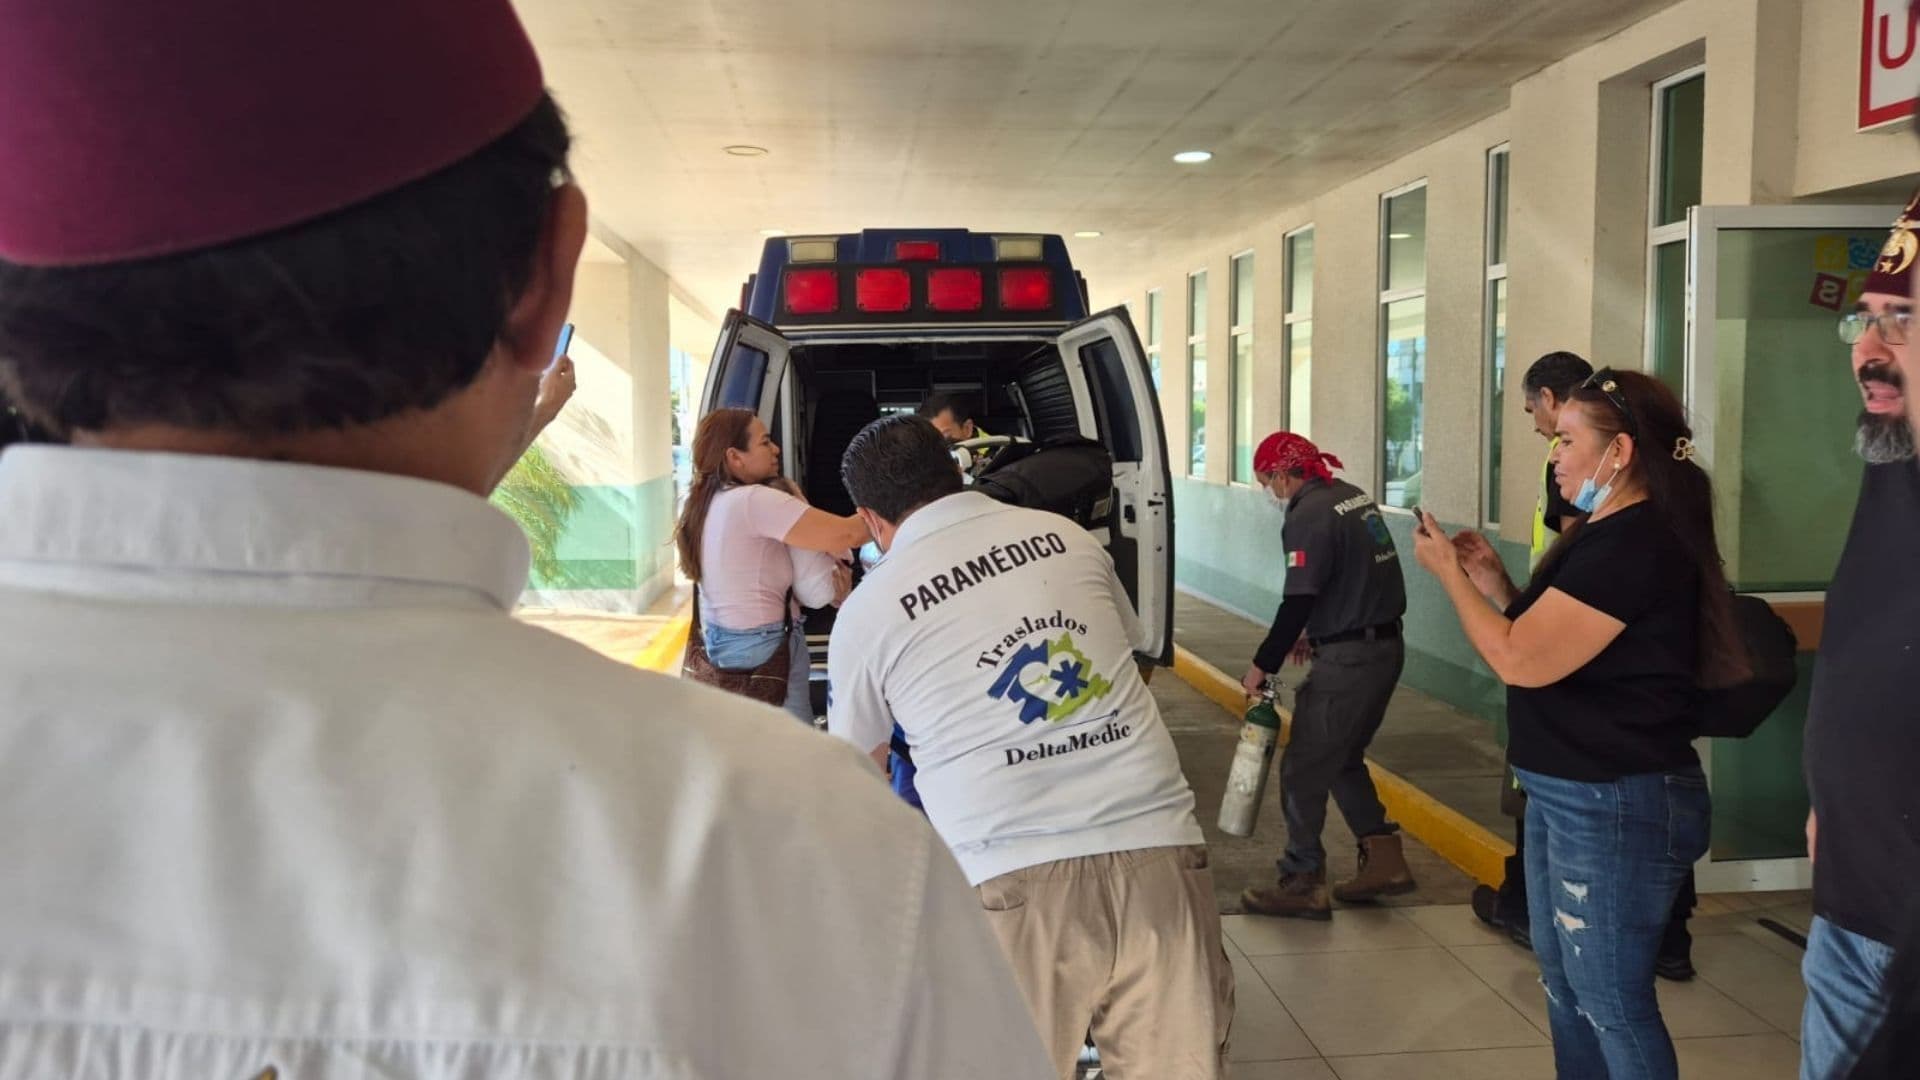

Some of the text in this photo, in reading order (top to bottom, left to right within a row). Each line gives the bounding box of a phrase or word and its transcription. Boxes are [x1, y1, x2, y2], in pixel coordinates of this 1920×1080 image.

[900, 532, 1067, 621] PARAMÉDICO
[976, 609, 1088, 669] Traslados
[1005, 721, 1132, 766] DeltaMedic
